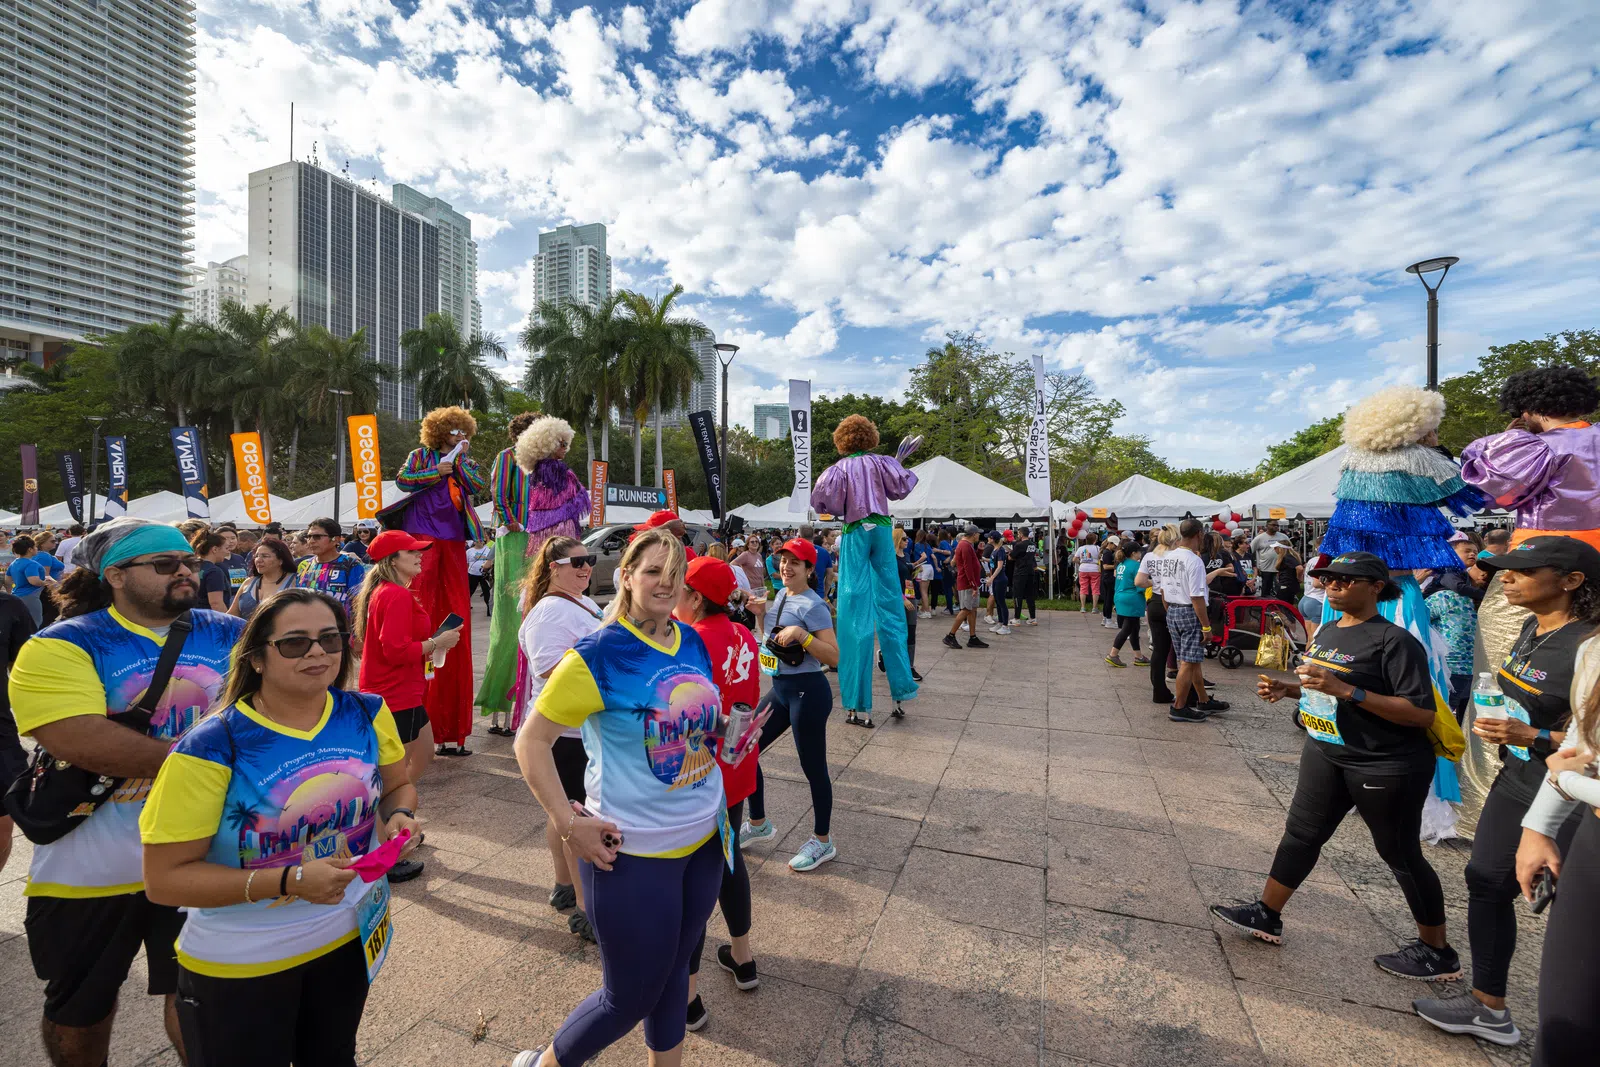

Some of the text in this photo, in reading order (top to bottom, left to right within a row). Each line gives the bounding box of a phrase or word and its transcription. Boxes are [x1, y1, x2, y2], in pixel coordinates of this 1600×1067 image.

[701, 427, 710, 443] TENT
[705, 443, 714, 463] AREA
[66, 462, 74, 474] TENT
[596, 464, 604, 489] BANK
[68, 474, 77, 488] AREA
[619, 489, 658, 503] RUNNERS
[112, 658, 141, 678] United
[1302, 713, 1336, 735] 13699
[258, 764, 283, 787] United
[283, 751, 315, 768] Property
[317, 747, 365, 756] Management
[317, 838, 336, 858] M
